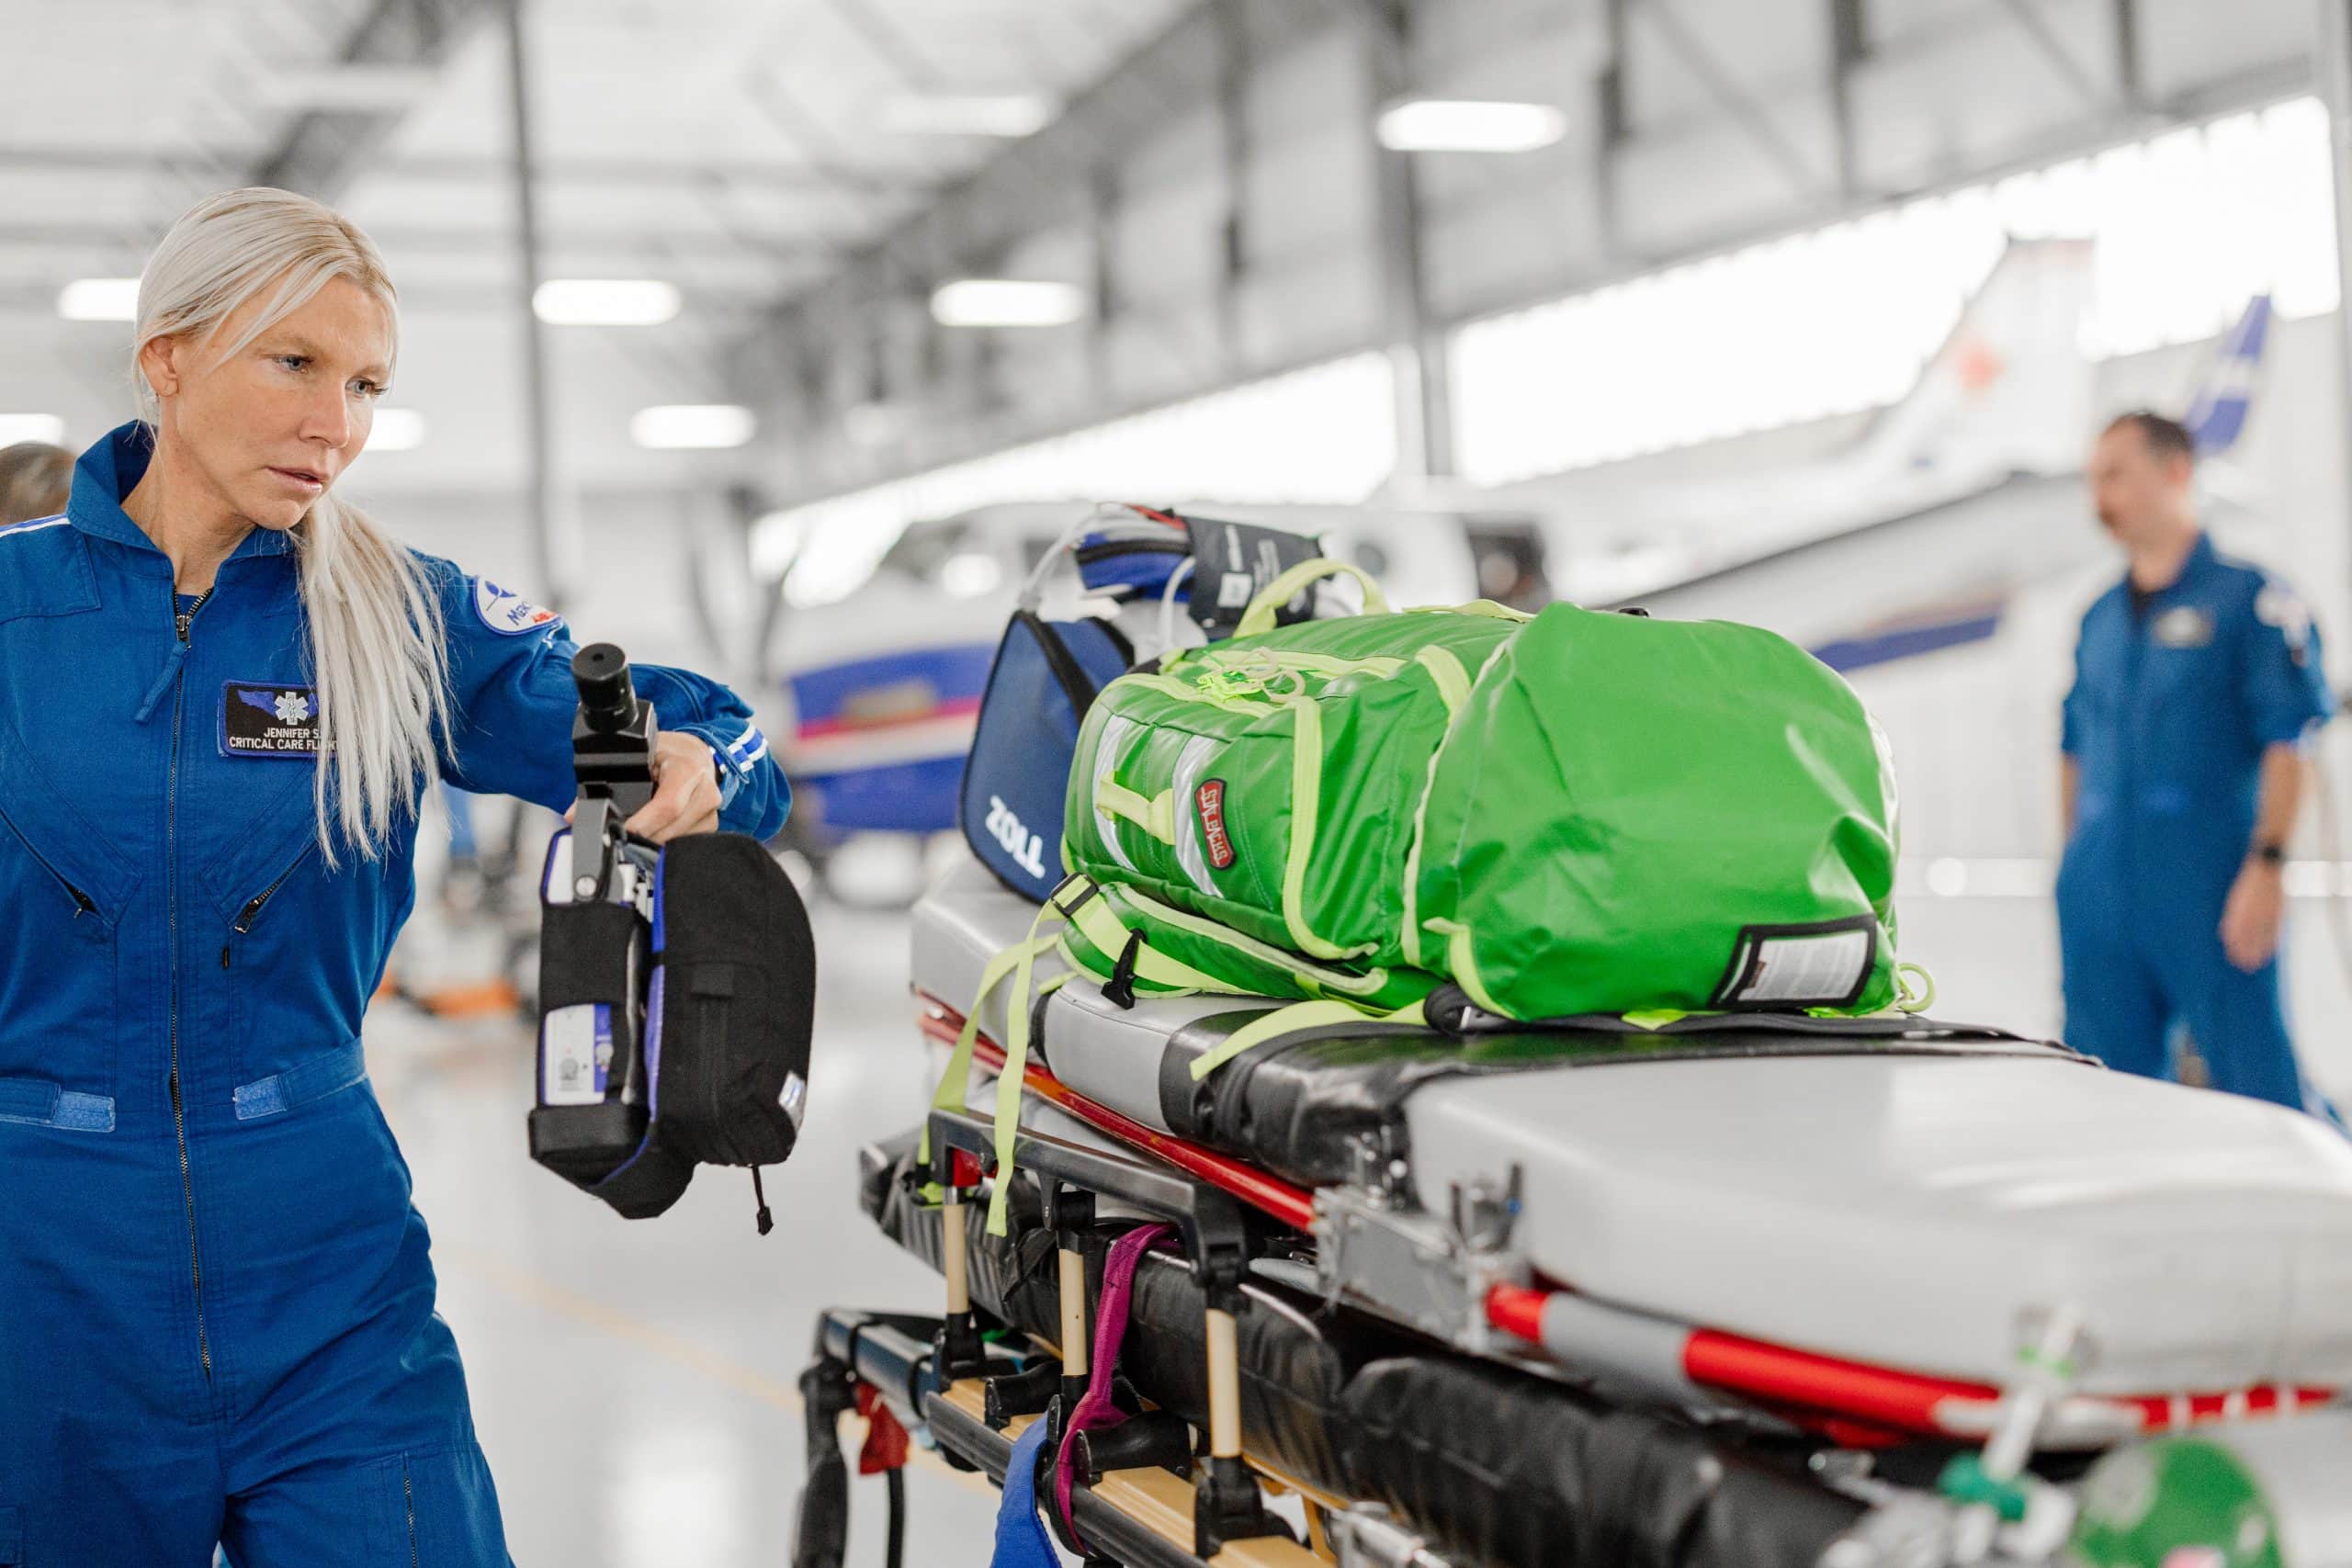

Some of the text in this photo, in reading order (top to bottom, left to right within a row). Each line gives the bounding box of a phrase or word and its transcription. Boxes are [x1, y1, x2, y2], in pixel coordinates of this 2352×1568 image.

[264, 728, 311, 739] JENNIFER
[229, 736, 275, 750] CRITICAL
[277, 739, 304, 750] CARE
[985, 795, 1046, 879] ZOLL
